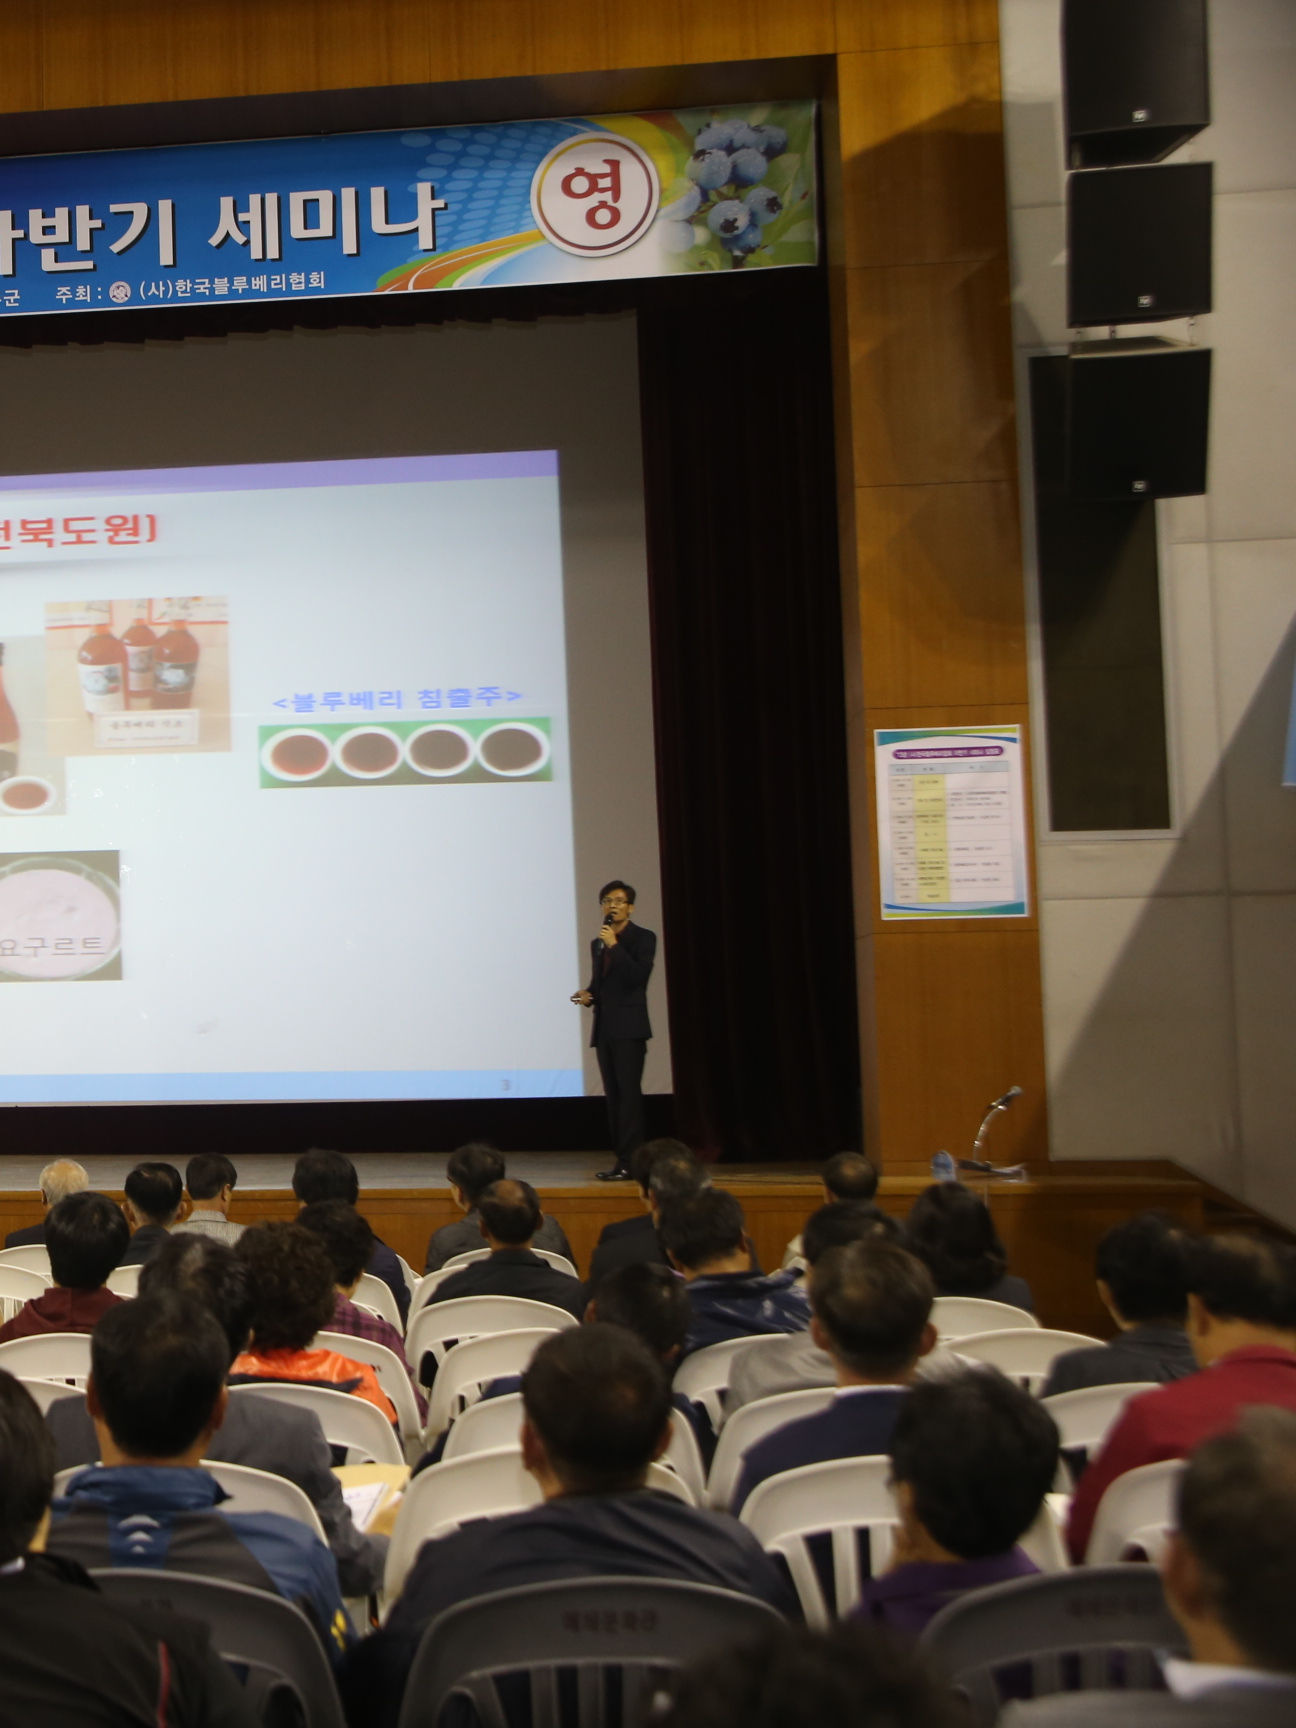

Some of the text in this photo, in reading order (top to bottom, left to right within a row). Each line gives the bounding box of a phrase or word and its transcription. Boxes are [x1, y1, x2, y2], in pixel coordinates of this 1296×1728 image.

[207, 181, 446, 261] 세미나
[560, 158, 621, 230] 영
[139, 270, 325, 300] (사)한국블루베리협회
